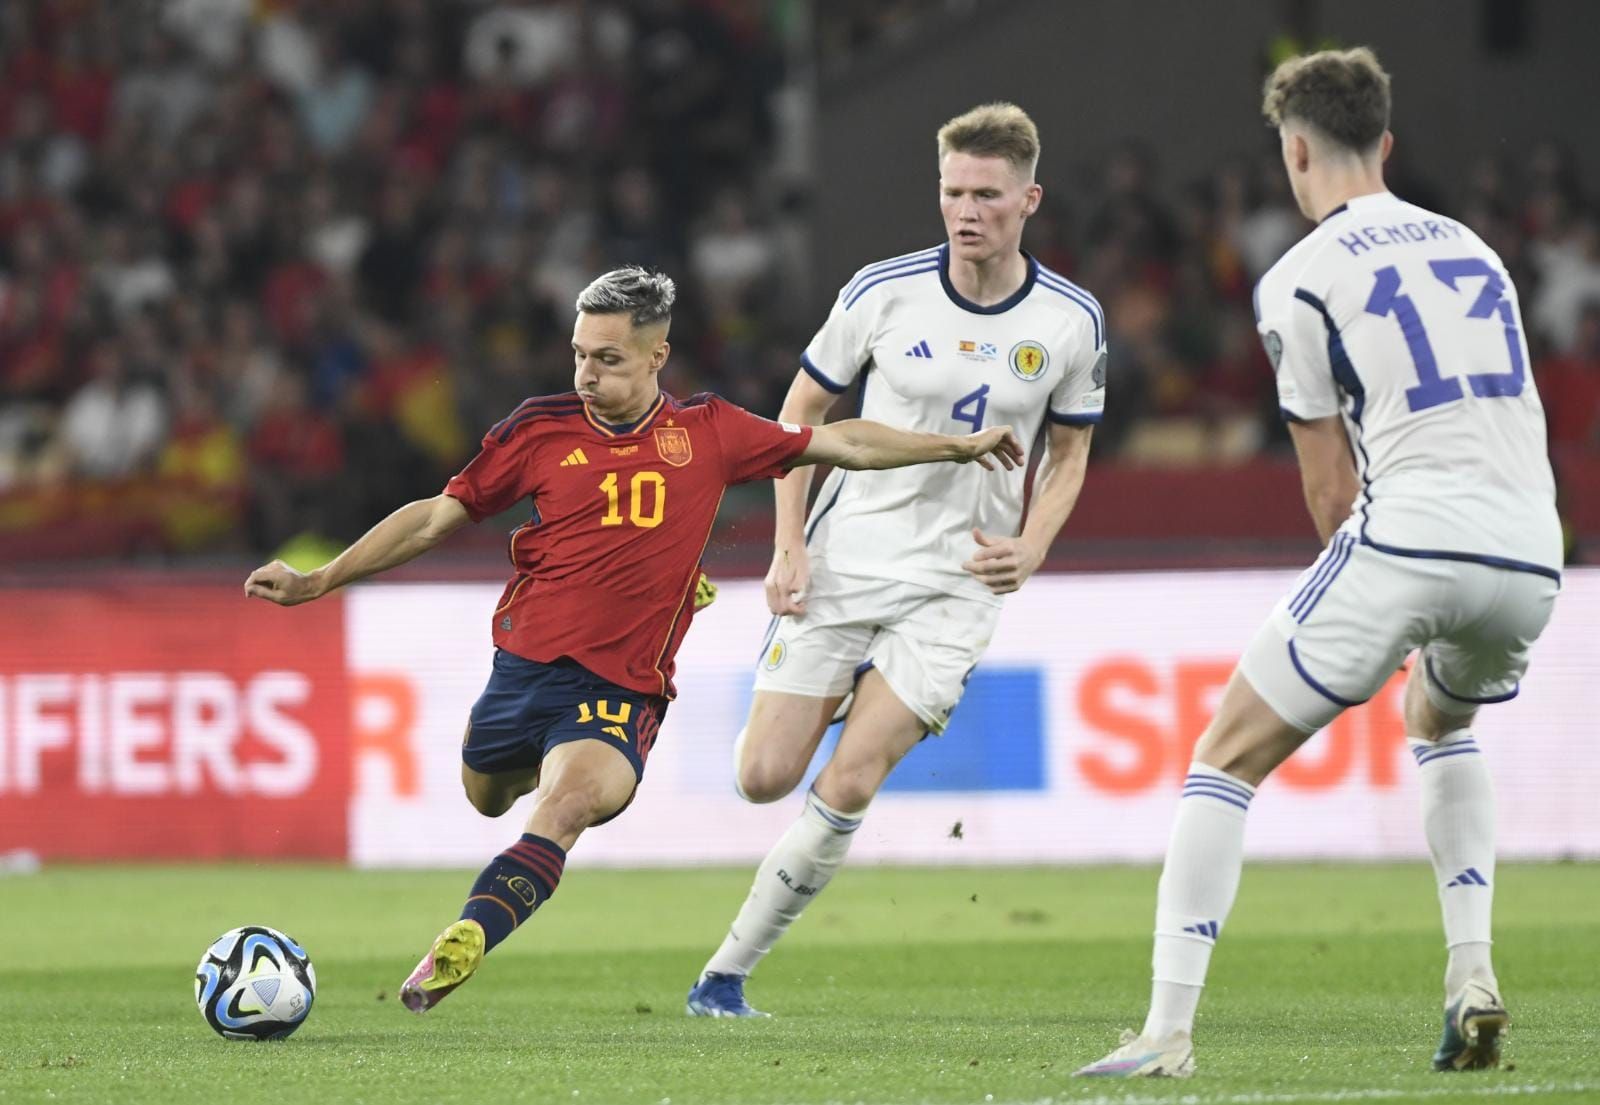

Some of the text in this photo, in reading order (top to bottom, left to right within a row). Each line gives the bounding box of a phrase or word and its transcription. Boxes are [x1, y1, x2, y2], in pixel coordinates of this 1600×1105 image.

[1338, 219, 1461, 256] HENDRY
[1364, 257, 1525, 413] 13
[951, 383, 990, 434] 4
[598, 471, 665, 527] 10
